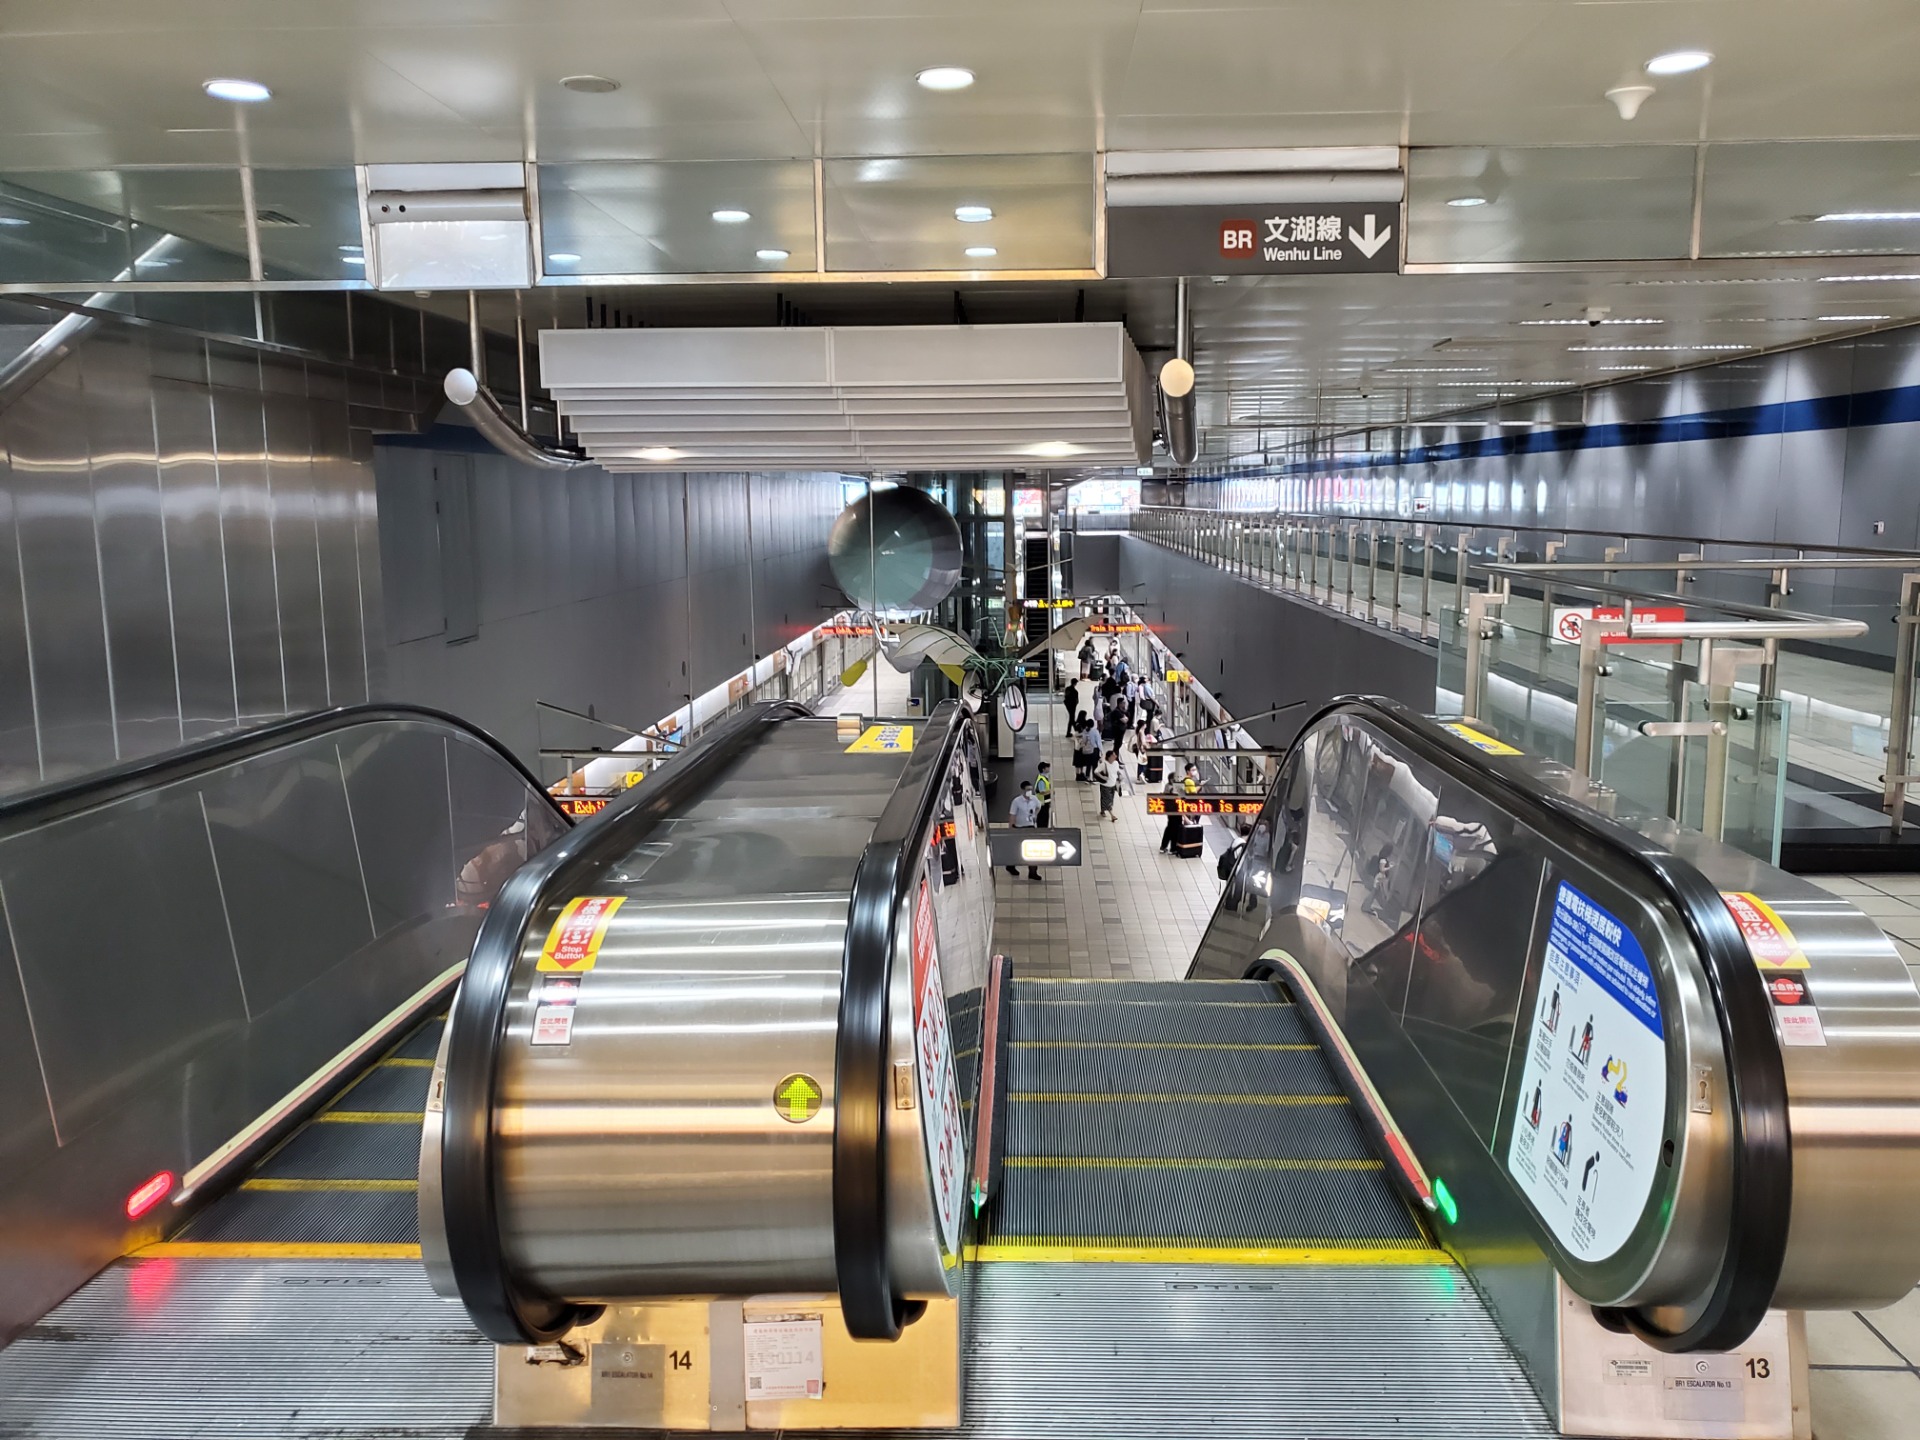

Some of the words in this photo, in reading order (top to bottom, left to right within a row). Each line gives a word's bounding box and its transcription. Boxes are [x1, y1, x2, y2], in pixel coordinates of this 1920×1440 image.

[1264, 216, 1342, 242] 文湖線
[1223, 229, 1253, 249] BR
[1263, 247, 1310, 261] Wenhu
[1313, 246, 1342, 261] Line
[1149, 798, 1165, 813] 站
[1176, 799, 1213, 813] Train
[1220, 799, 1233, 813] is
[554, 952, 585, 960] Button
[561, 945, 583, 953] Stop
[669, 1350, 692, 1370] 14
[1745, 1358, 1770, 1378] 13
[1675, 1379, 1686, 1387] BR1
[1686, 1380, 1716, 1388] ESCALATOR
